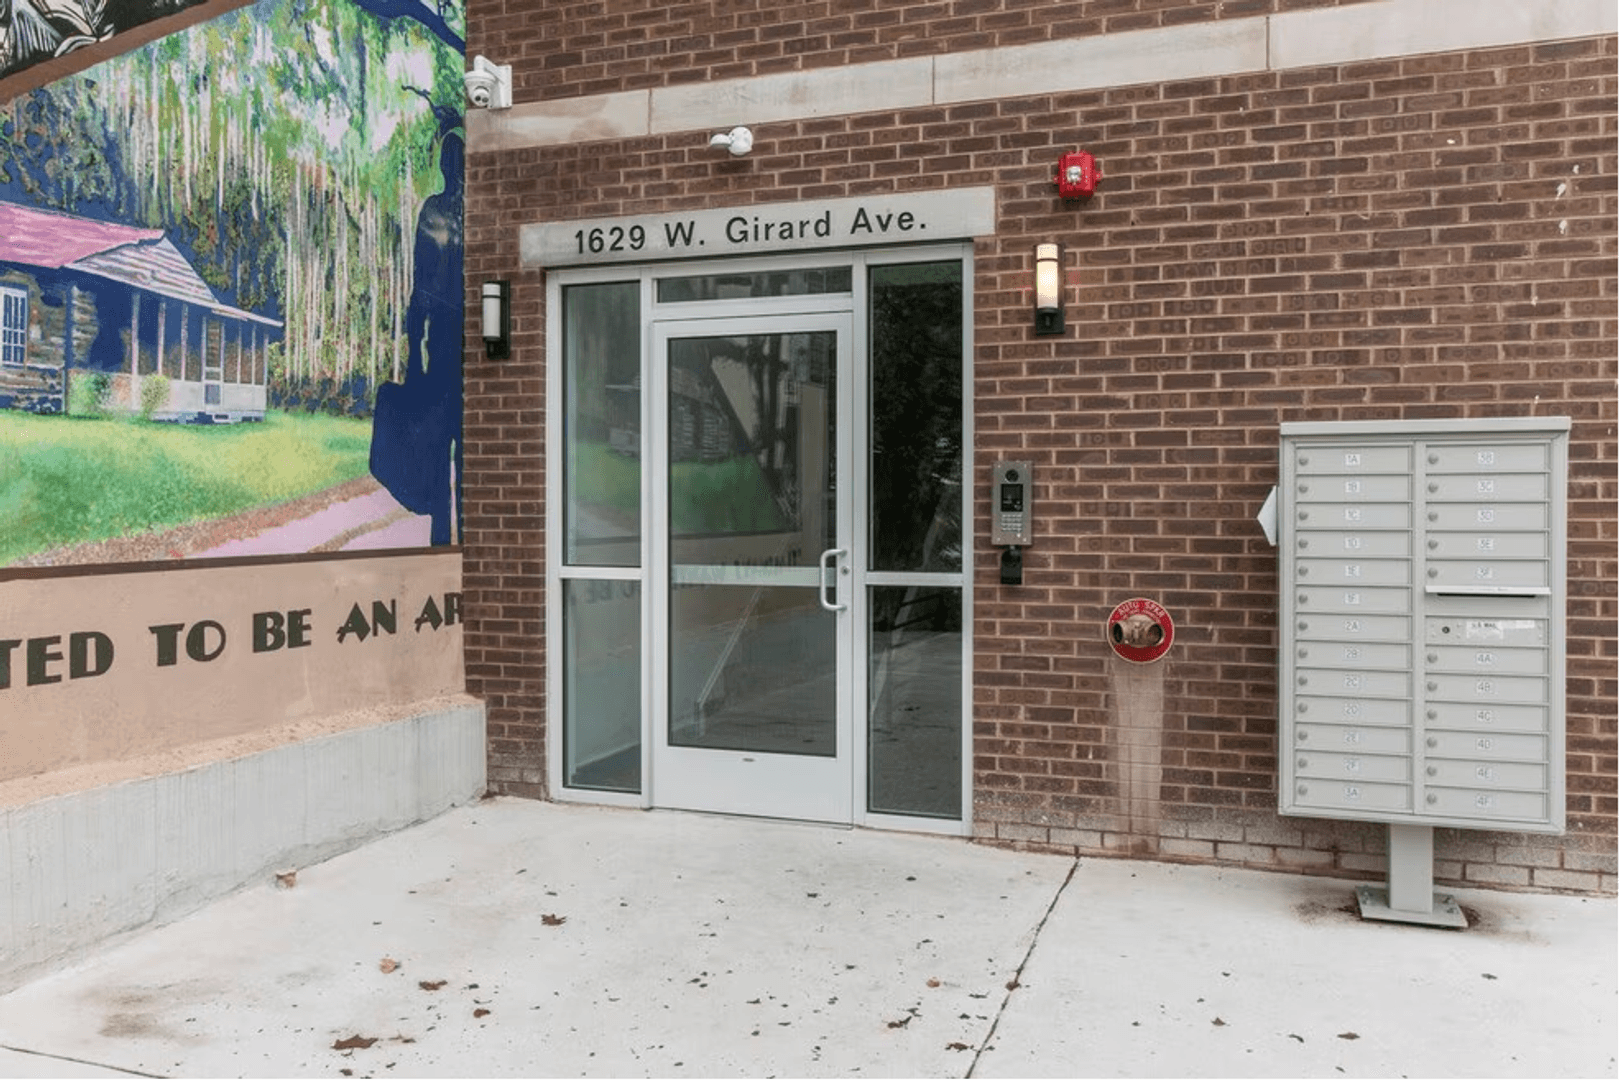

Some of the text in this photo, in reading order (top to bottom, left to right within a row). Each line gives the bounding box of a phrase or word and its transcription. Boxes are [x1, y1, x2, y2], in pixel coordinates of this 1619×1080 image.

[574, 207, 927, 254] 1629 W. Girard Ave.
[148, 619, 227, 667] TO
[252, 608, 312, 653] BE
[336, 599, 397, 644] AN
